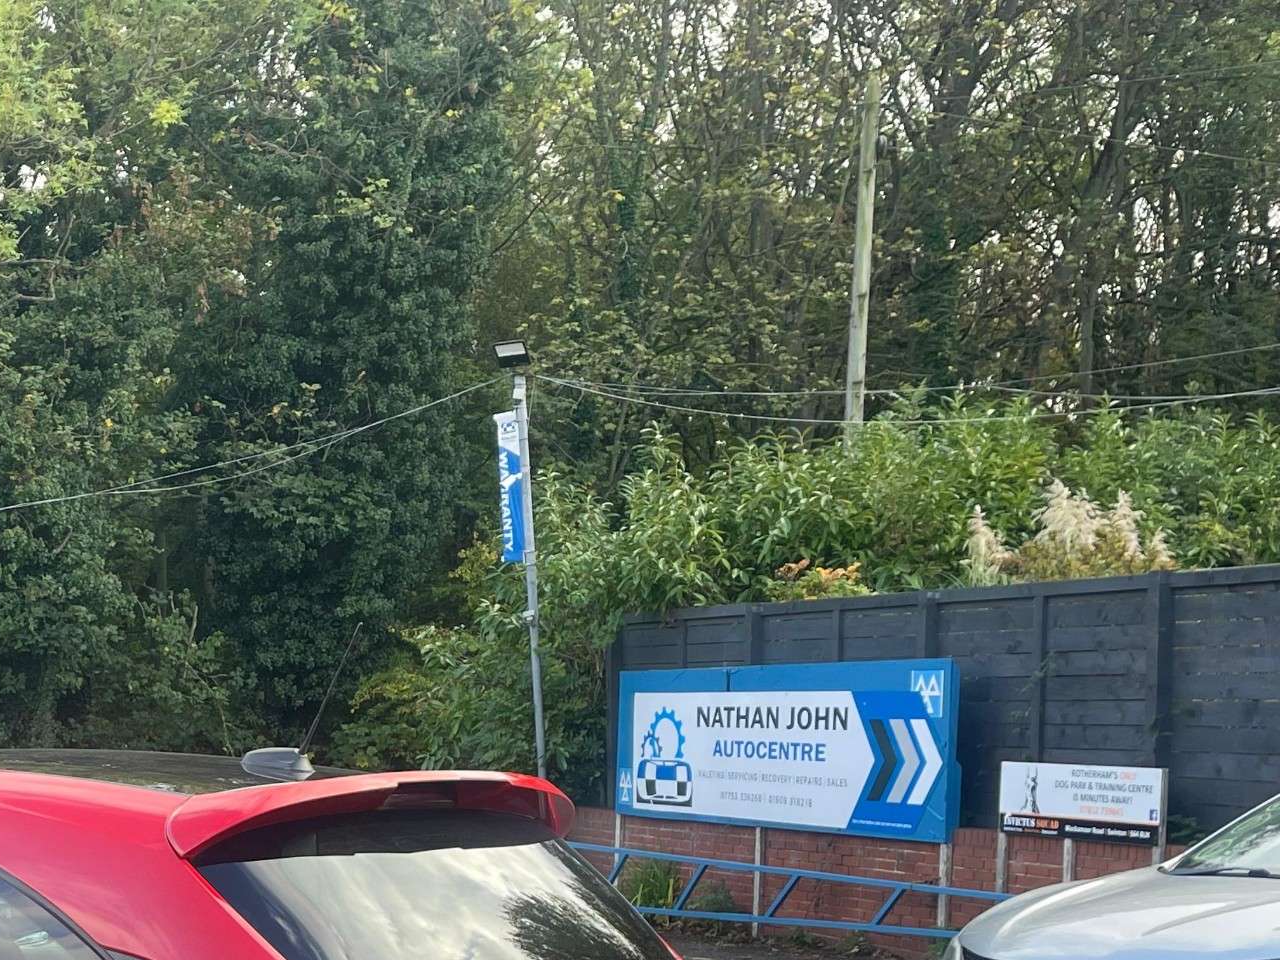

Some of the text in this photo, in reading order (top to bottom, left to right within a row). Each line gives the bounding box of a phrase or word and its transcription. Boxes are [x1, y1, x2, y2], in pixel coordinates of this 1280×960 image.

[696, 705, 849, 732] NATHAN JOHN
[712, 739, 827, 762] AUTOCENTRE
[761, 773, 793, 784] RECOVERY
[795, 775, 822, 786] REPAIRS
[826, 777, 848, 788] SALES
[1070, 780, 1086, 790] PARK
[1095, 782, 1127, 793] TRAINING
[1127, 784, 1153, 794] CENTRE
[1080, 793, 1109, 804] MINUTES
